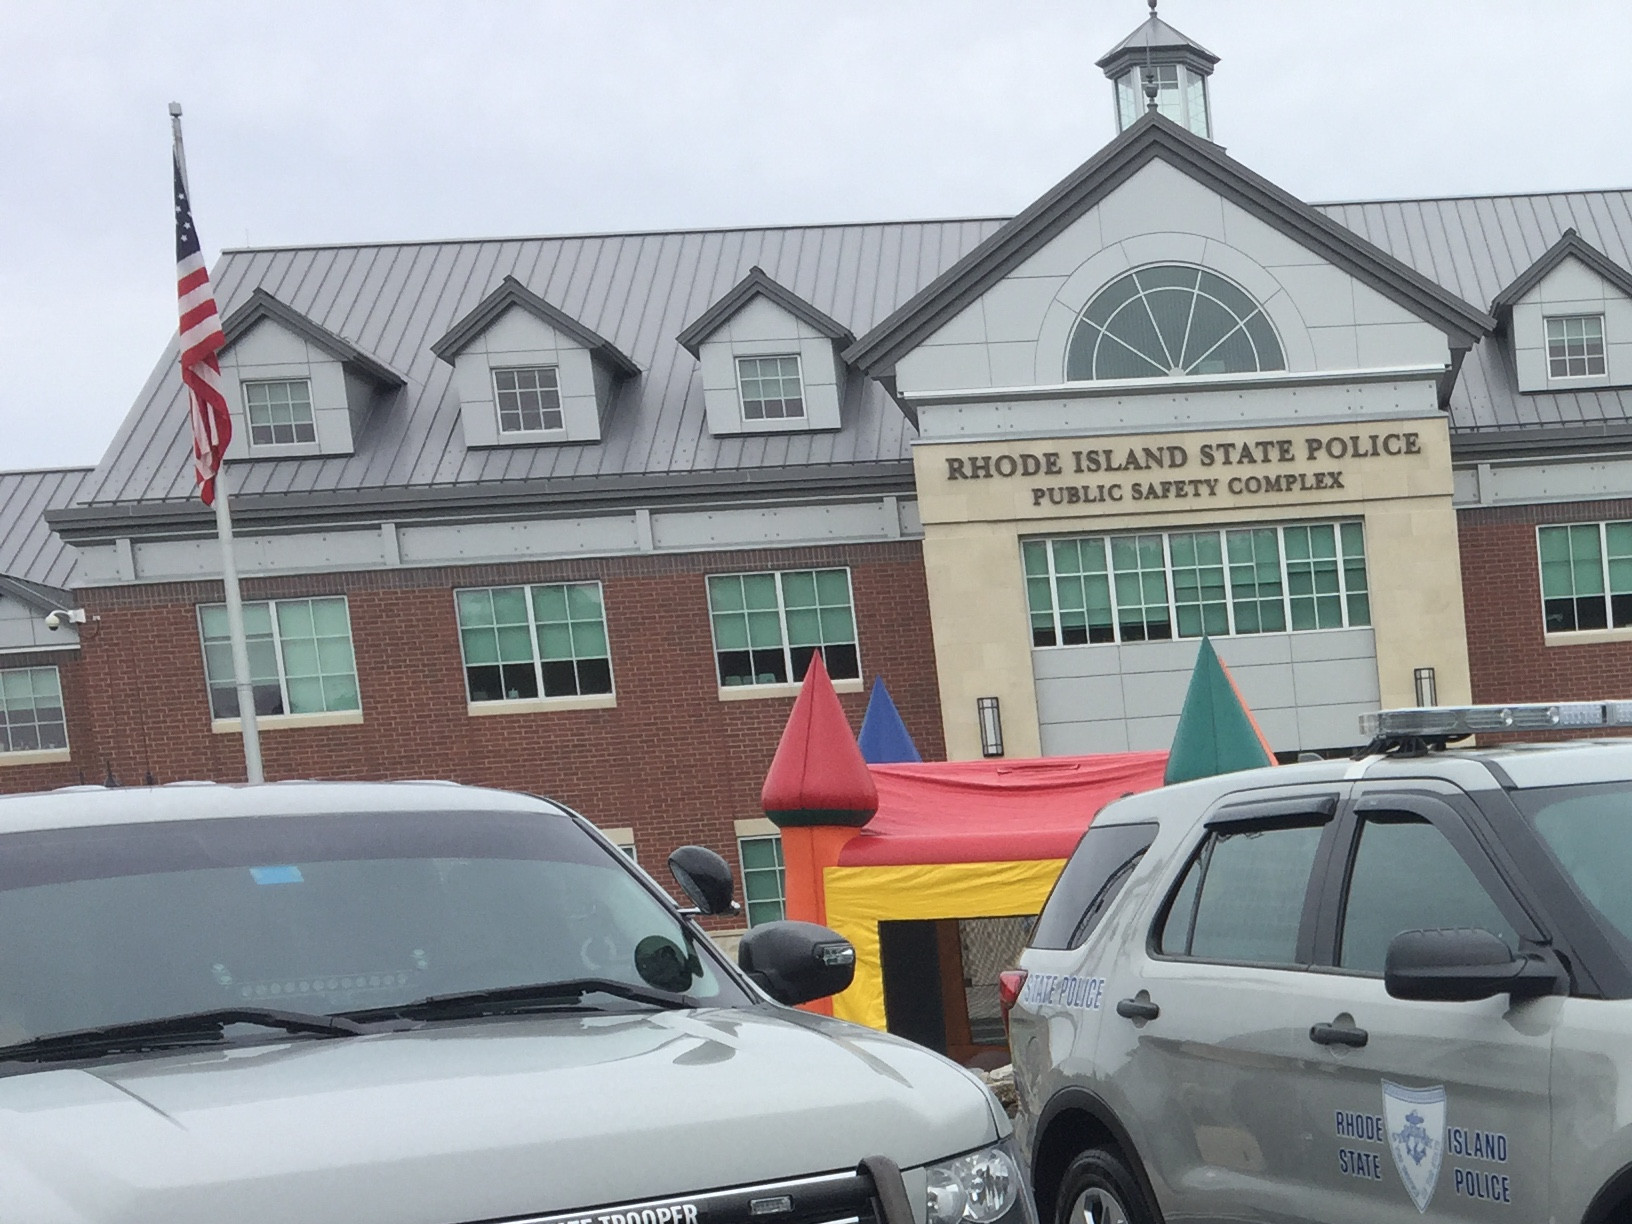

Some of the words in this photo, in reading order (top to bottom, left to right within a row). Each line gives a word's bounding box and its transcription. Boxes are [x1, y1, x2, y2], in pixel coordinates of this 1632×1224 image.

[946, 451, 1062, 480] RHODE
[1073, 445, 1188, 473] ISLAND
[1200, 439, 1296, 466] STATE
[1305, 432, 1422, 461] POLICE
[1032, 484, 1123, 506] PUBLIC
[1131, 477, 1220, 500] SAFETY
[1228, 471, 1345, 494] COMPLEX
[1024, 974, 1058, 1004] STATE
[1059, 976, 1105, 1009] POLICE
[1336, 1111, 1383, 1142] RHODE
[1448, 1127, 1507, 1162] ISLAND
[1338, 1149, 1381, 1180] STATE
[1454, 1168, 1510, 1203] POLICE
